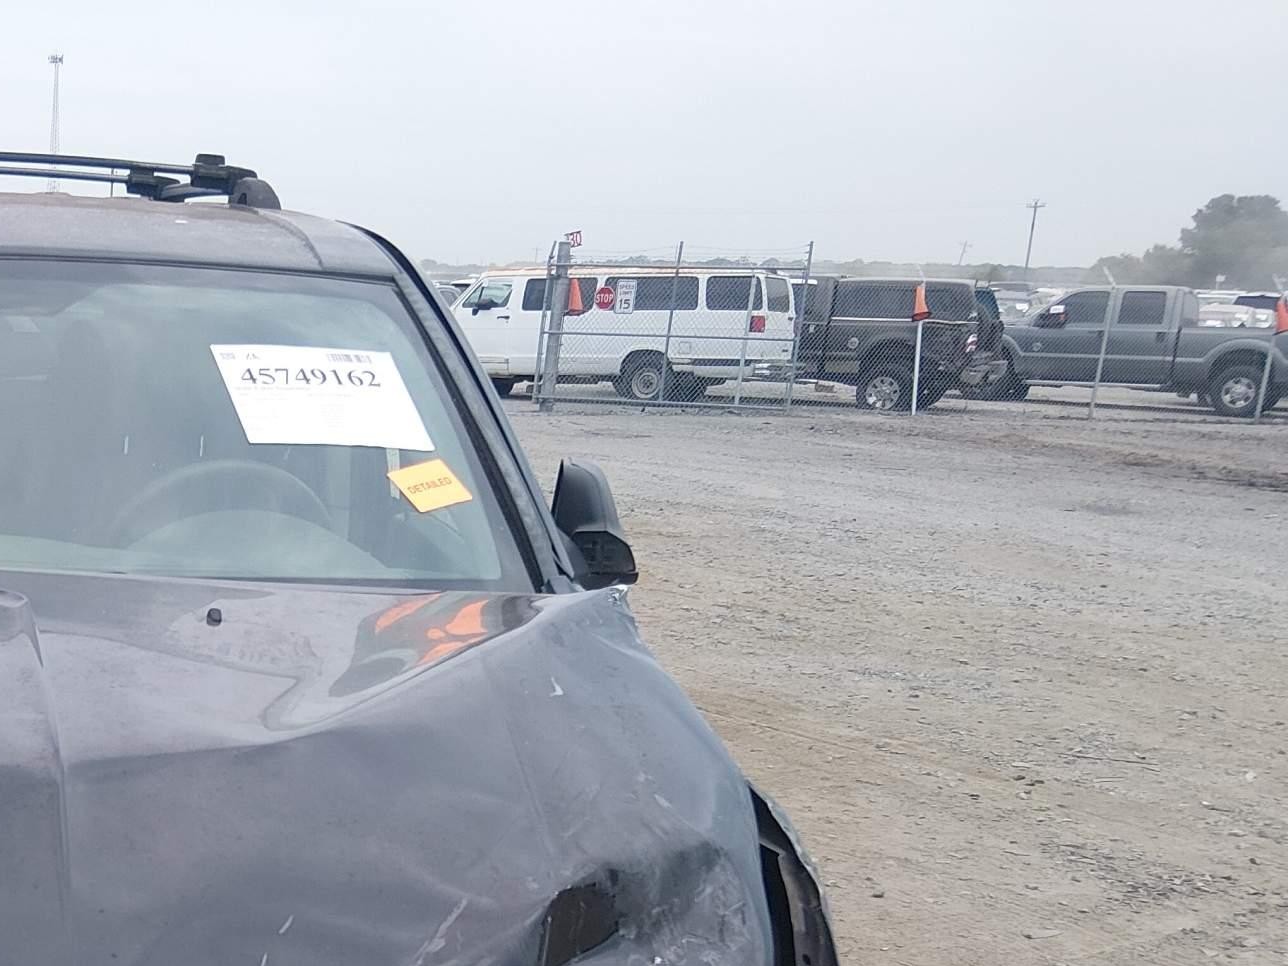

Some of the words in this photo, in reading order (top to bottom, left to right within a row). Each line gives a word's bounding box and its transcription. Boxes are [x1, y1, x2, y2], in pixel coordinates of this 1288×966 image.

[596, 293, 614, 303] STOP
[619, 298, 630, 310] 15
[240, 367, 382, 388] 45749162
[407, 477, 453, 494] DETAILED
